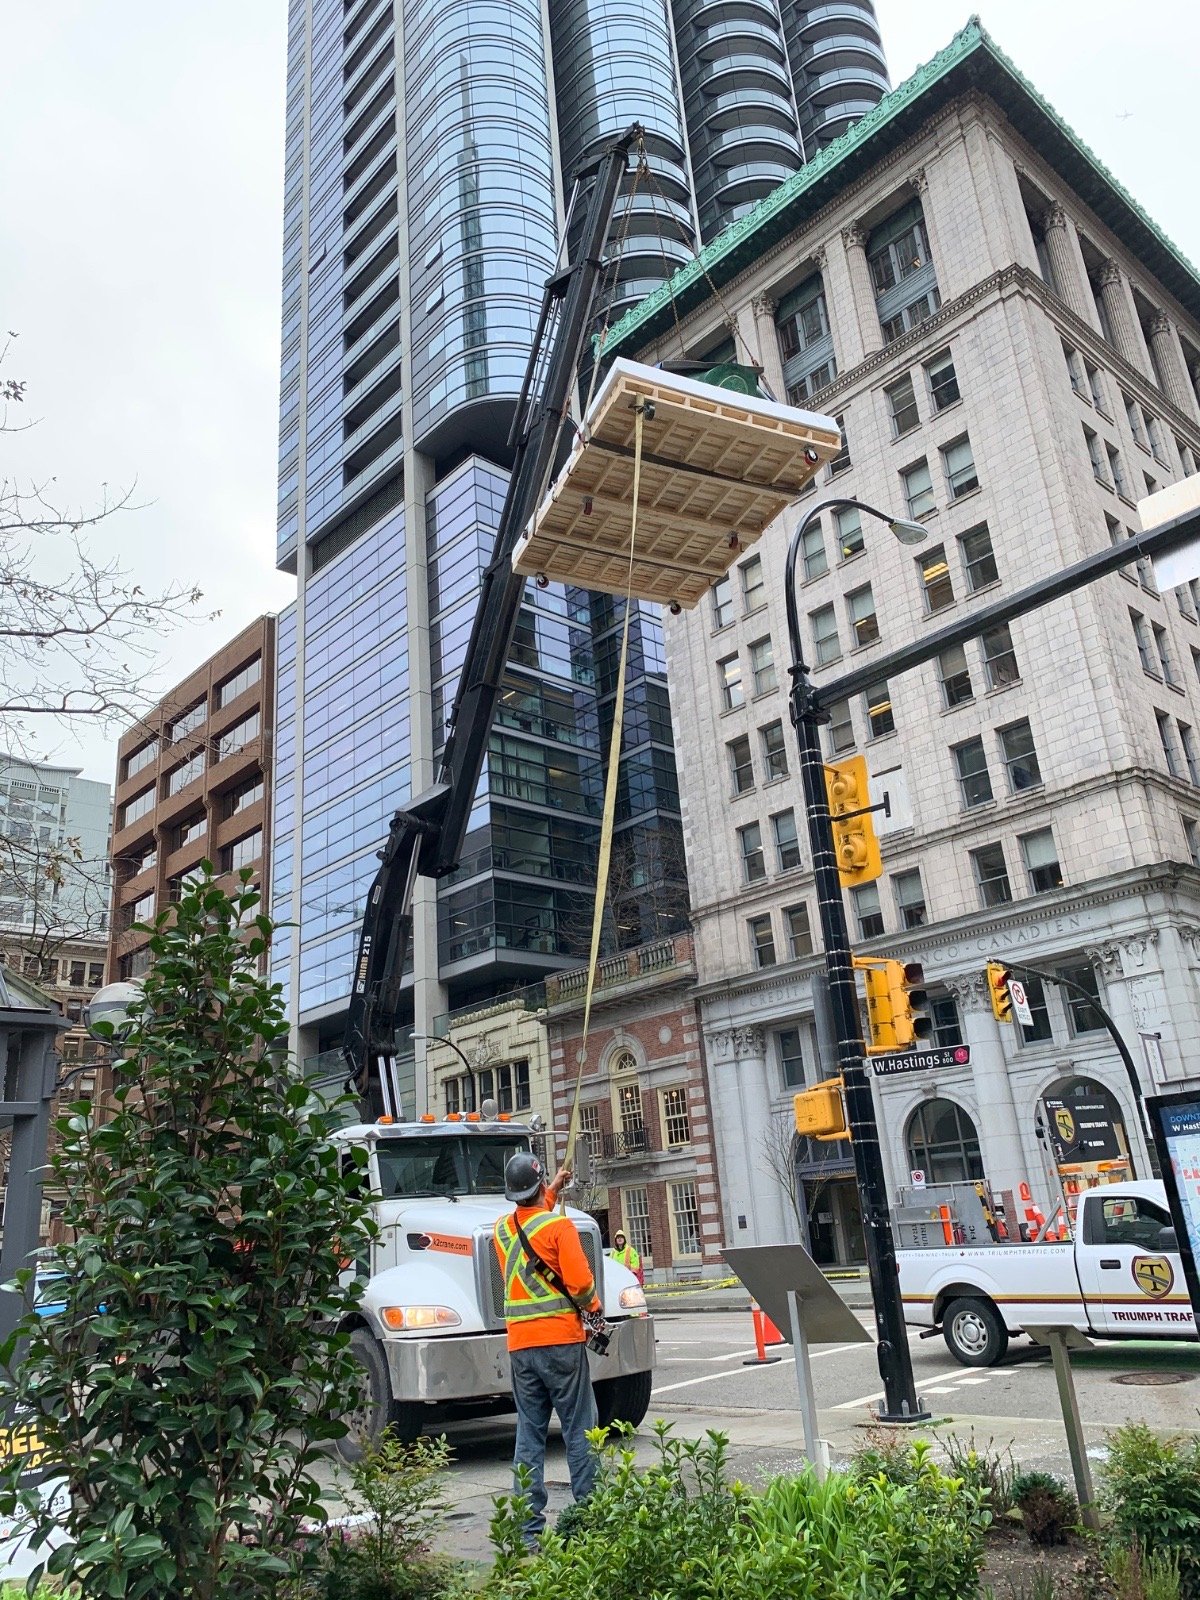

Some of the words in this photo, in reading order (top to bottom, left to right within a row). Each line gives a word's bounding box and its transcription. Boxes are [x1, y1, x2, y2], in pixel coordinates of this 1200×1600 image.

[977, 914, 1082, 951] CANADIEN
[363, 936, 372, 955] 215
[359, 956, 369, 979] HIAB
[874, 1055, 940, 1073] W.Hastings
[433, 1238, 468, 1251] k2crane.com
[1112, 1312, 1162, 1322] TRIUMPH
[1164, 1312, 1193, 1322] TRAF
